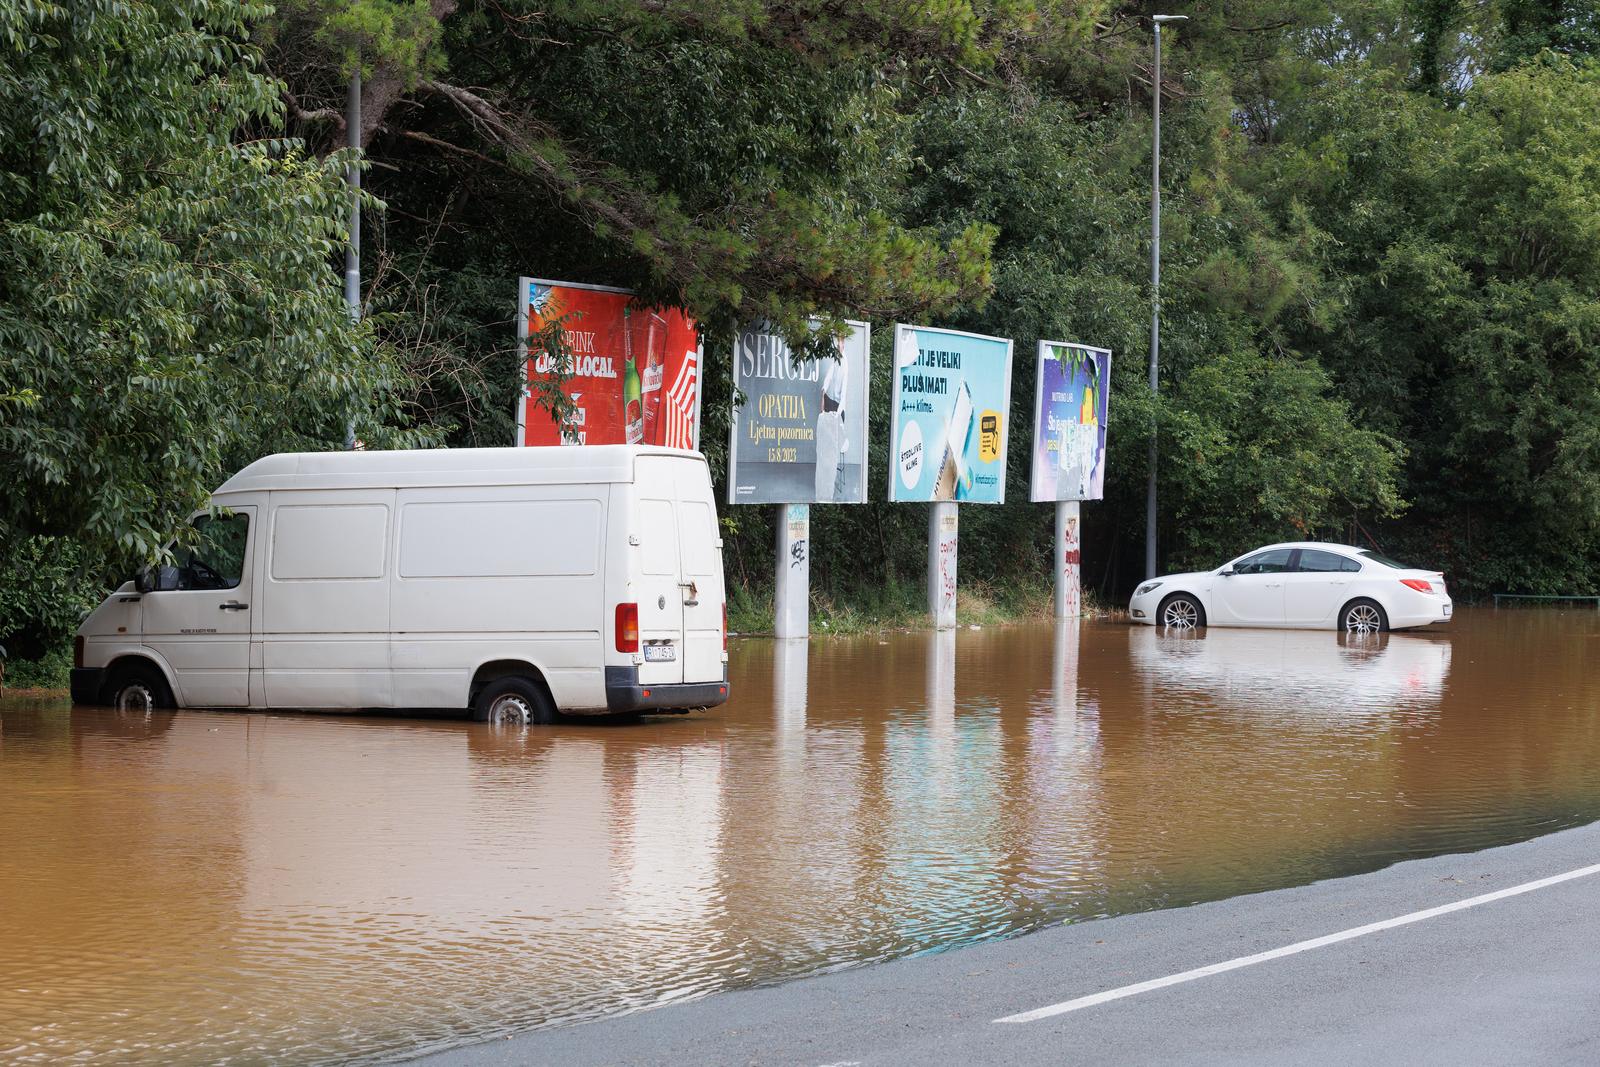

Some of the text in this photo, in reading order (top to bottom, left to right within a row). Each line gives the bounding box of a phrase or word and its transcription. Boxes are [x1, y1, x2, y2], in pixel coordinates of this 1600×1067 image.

[575, 355, 617, 378] LOCAL.
[925, 350, 935, 367] JE
[936, 350, 961, 369] VELIKI
[902, 375, 947, 395] PLUS IMATI
[758, 393, 807, 419] OPATIJA
[749, 419, 814, 448] Ljetna pozornica
